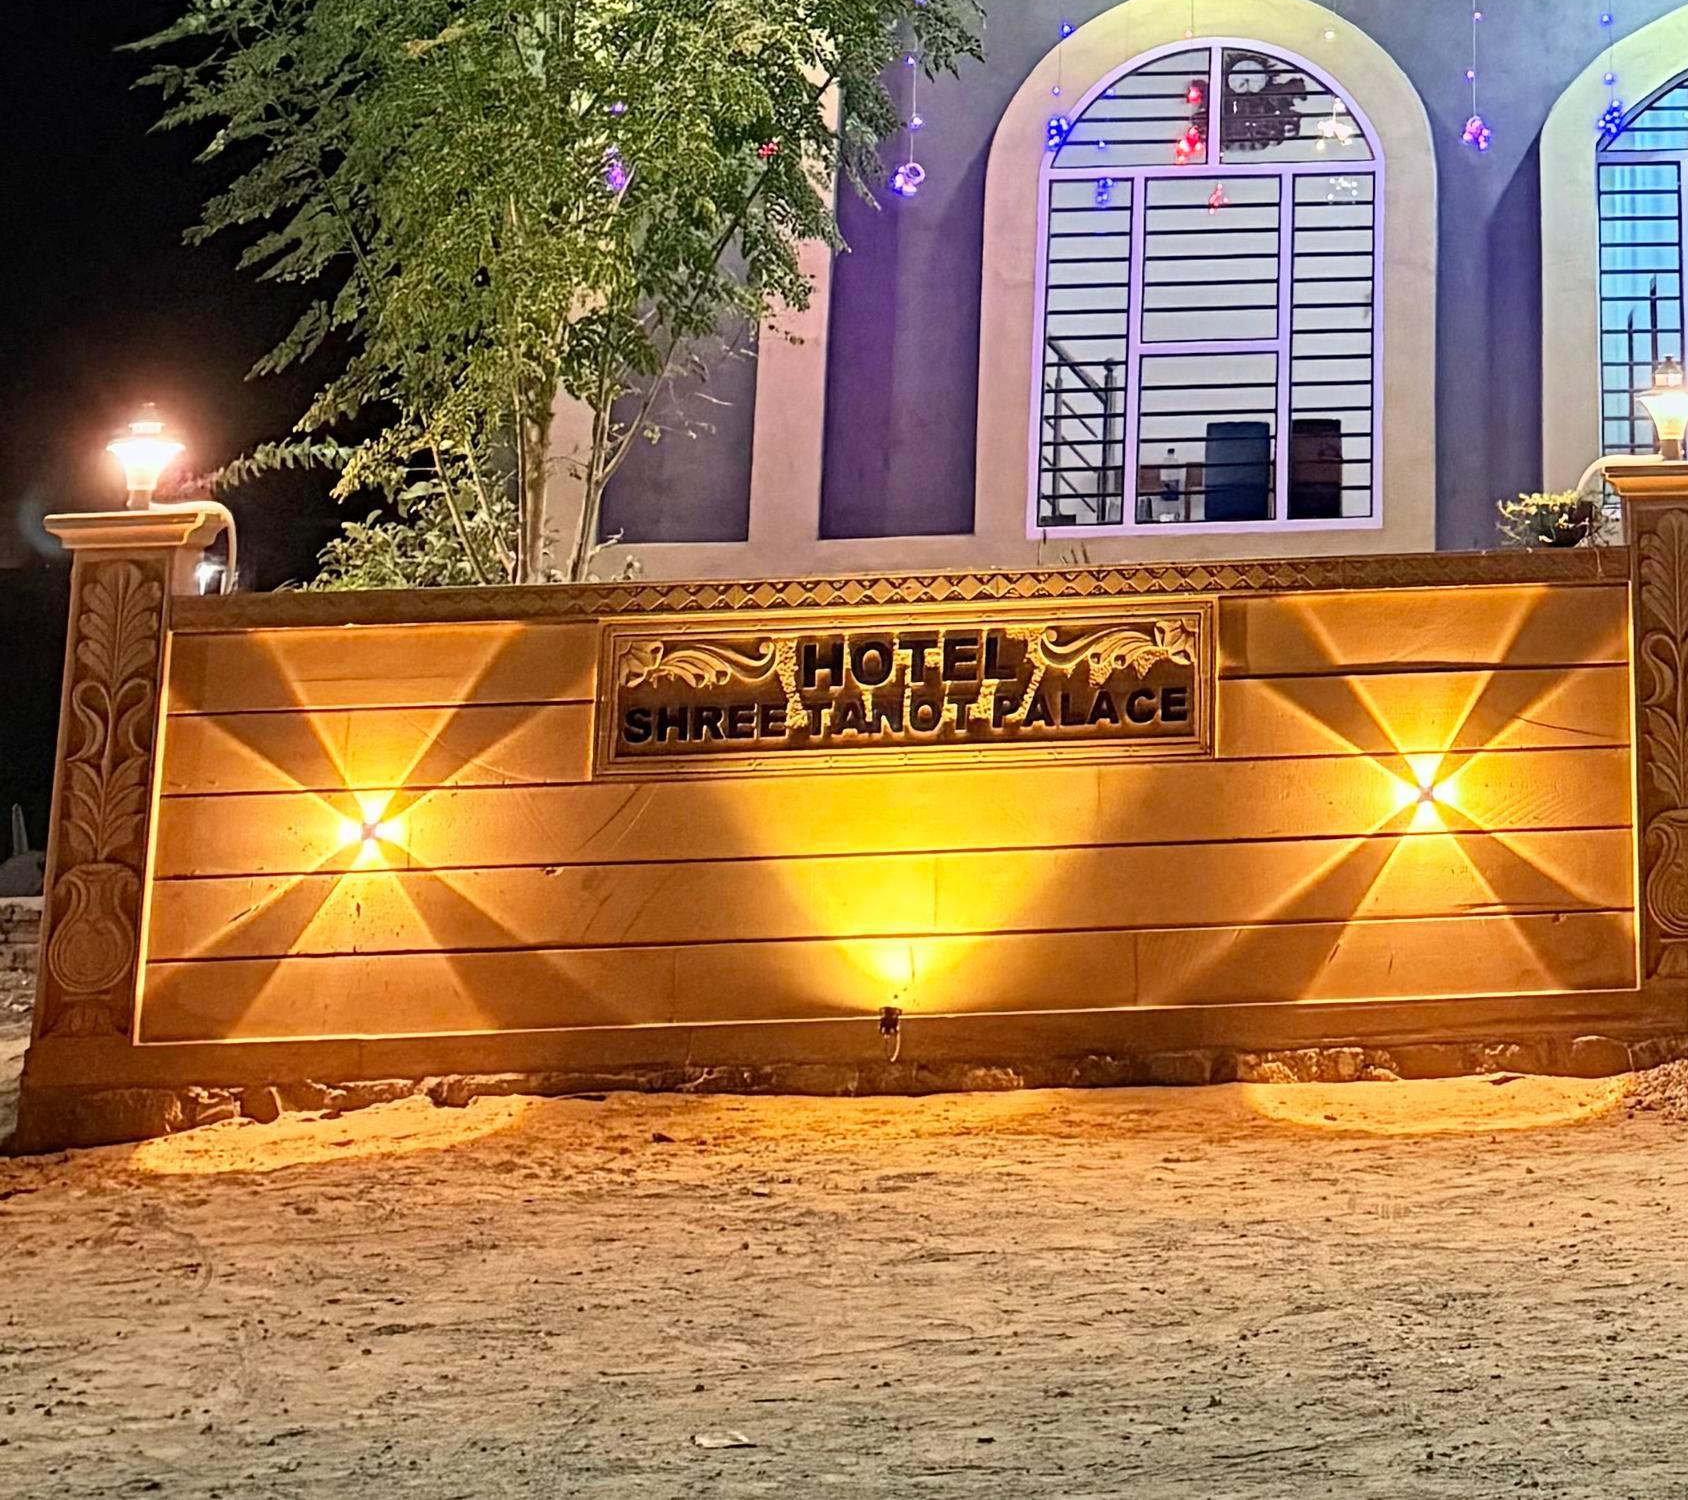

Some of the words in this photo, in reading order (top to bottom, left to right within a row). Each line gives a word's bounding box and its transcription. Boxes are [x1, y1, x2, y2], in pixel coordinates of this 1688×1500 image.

[801, 630, 1019, 689] HOTEL
[621, 702, 788, 746] SHREE
[805, 694, 975, 738] TANOT
[992, 685, 1190, 731] PALACE
